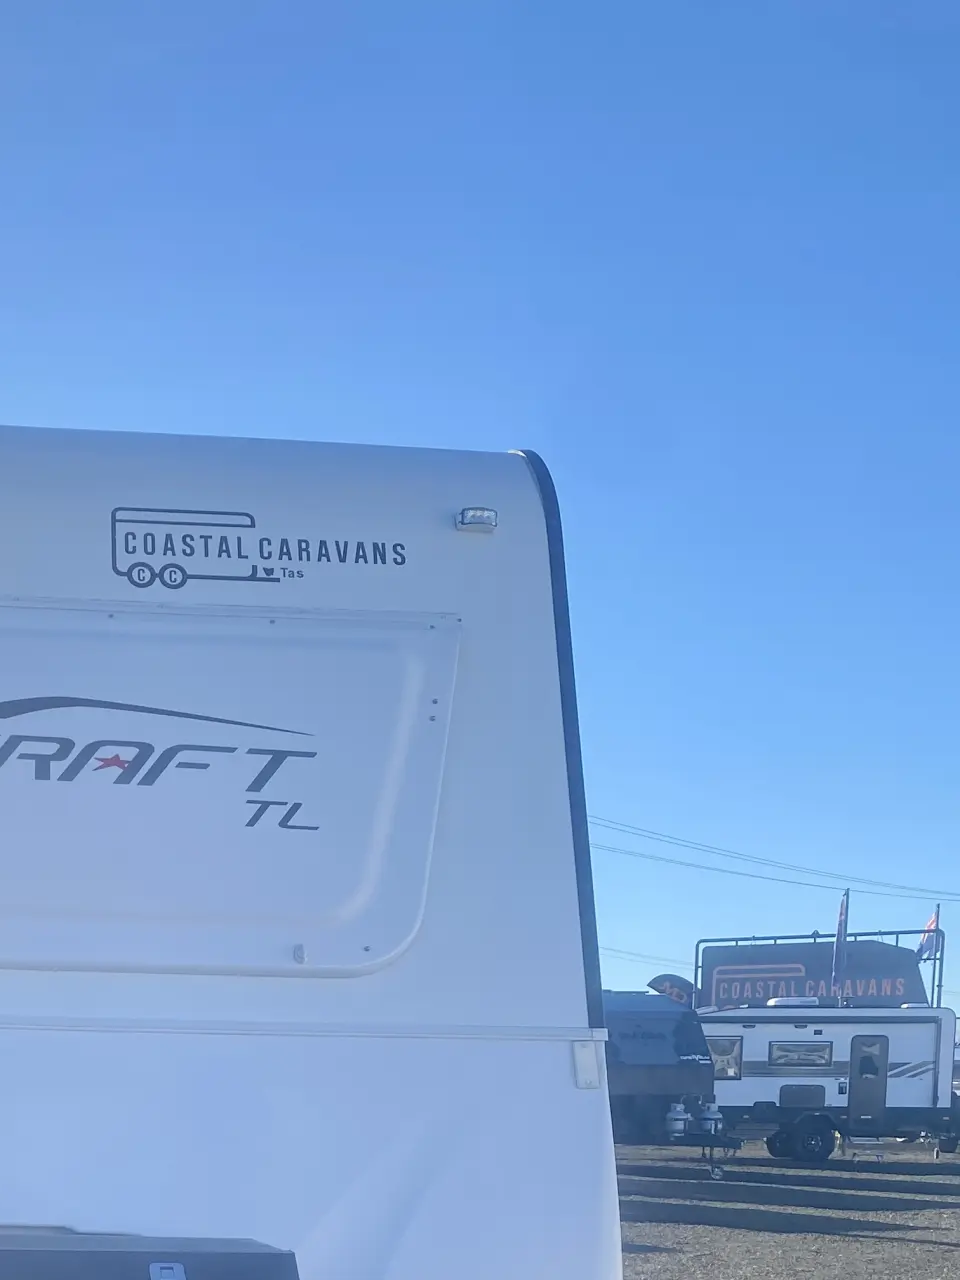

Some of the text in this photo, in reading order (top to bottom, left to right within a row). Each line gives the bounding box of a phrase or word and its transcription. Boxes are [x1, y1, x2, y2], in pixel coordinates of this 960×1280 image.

[124, 531, 407, 566] COASTAL CARAVANS
[280, 567, 304, 579] Tas
[245, 800, 320, 831] TL
[719, 979, 799, 999] COASTAL
